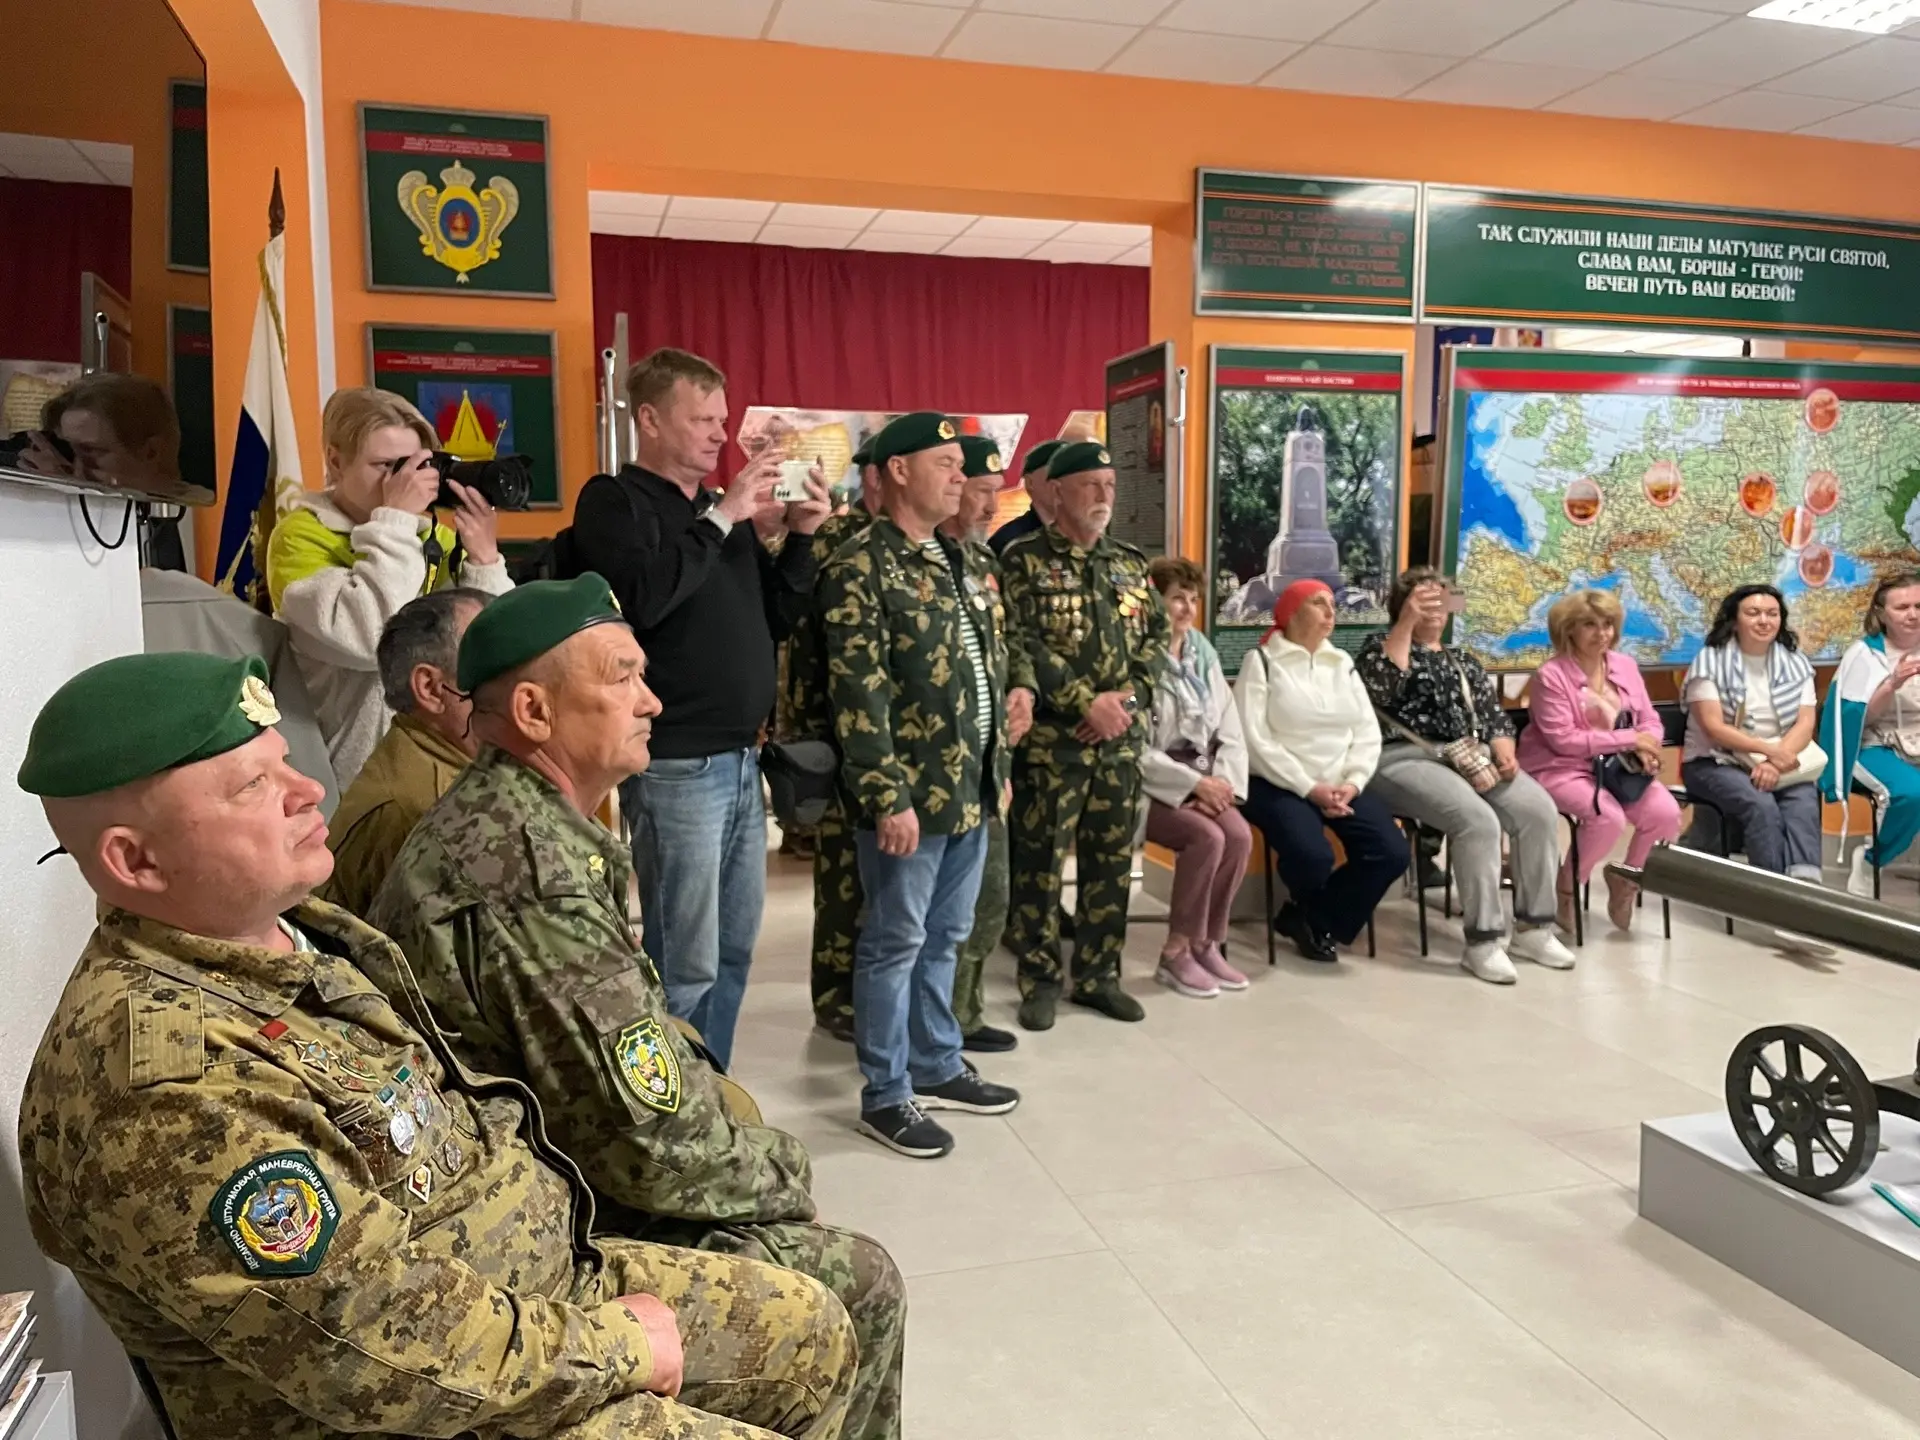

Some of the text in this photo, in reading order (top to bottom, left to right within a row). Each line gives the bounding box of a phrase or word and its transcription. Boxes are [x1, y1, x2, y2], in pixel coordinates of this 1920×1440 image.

[1477, 223, 1890, 270] ТАК СЛУЖИЛИ НАШИ ДЕДЫ МАТУШКЕ РУСИ СВЯТОЙ,
[1577, 251, 1632, 271] СЛАВА
[1637, 254, 1676, 275] ВАМ,
[1681, 258, 1736, 277] БОРЦЫ
[1585, 273, 1638, 293] ВЕЧЕН
[1643, 277, 1687, 296] ПУТЬ
[1691, 280, 1726, 298] ВАШ
[258, 1159, 322, 1190] МАНЕВРЕННАЯ
[223, 1169, 257, 1225] ШТУРМОВАЯ
[317, 1188, 338, 1221] ГРУППА
[229, 1229, 260, 1271] ДЕСАНТНО
